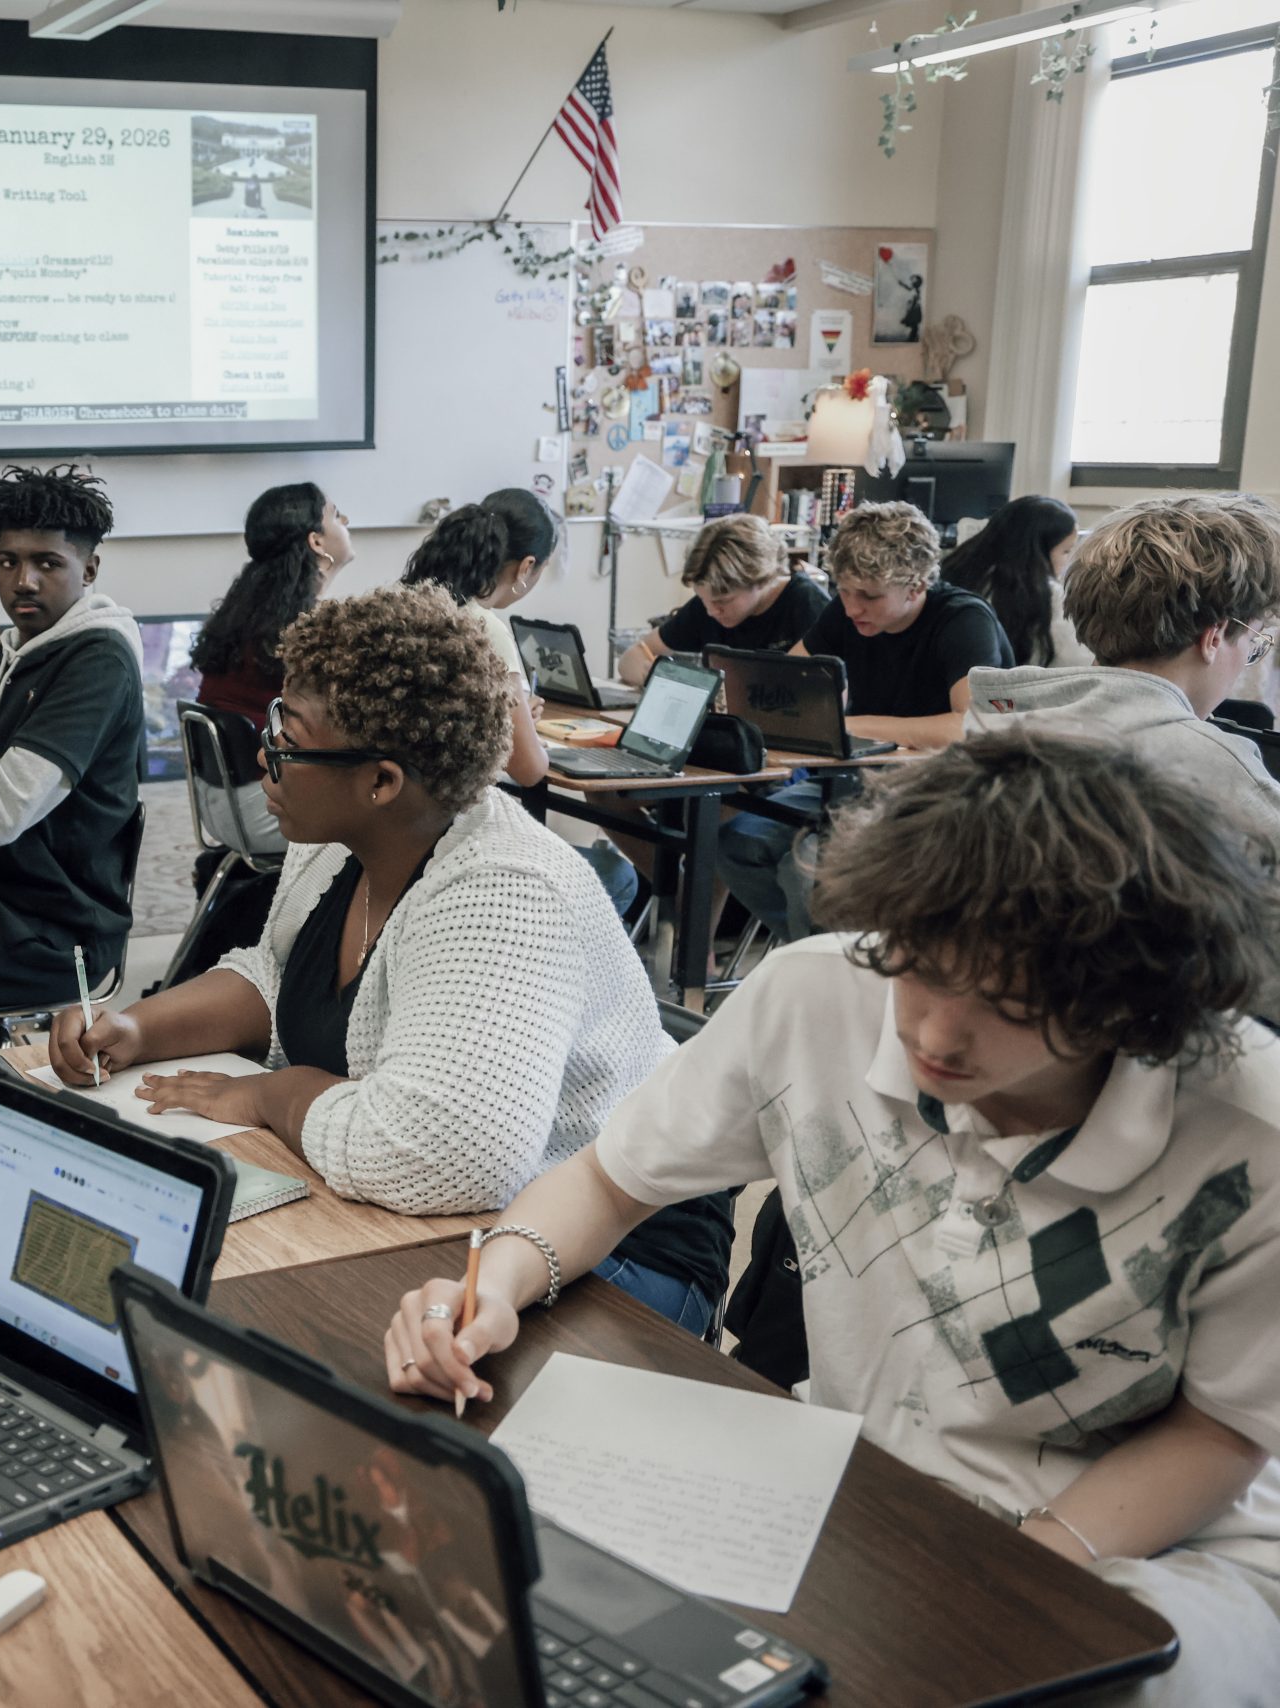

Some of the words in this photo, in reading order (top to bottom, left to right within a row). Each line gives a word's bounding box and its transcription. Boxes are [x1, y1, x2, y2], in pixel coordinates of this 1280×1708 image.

[82, 127, 114, 150] 29,
[121, 128, 171, 148] 2026
[44, 153, 96, 167] English
[3, 188, 55, 202] Writing
[59, 190, 88, 201] Tool
[67, 293, 81, 303] be
[85, 293, 115, 305] ready
[120, 293, 131, 303] to
[134, 293, 166, 303] share
[40, 333, 81, 345] coming
[83, 333, 96, 342] to
[99, 331, 129, 342] class
[21, 406, 76, 419] CHARGED
[79, 405, 154, 419] Chromebook
[157, 405, 169, 417] to
[174, 404, 208, 416] class
[234, 1443, 385, 1569] Helix
